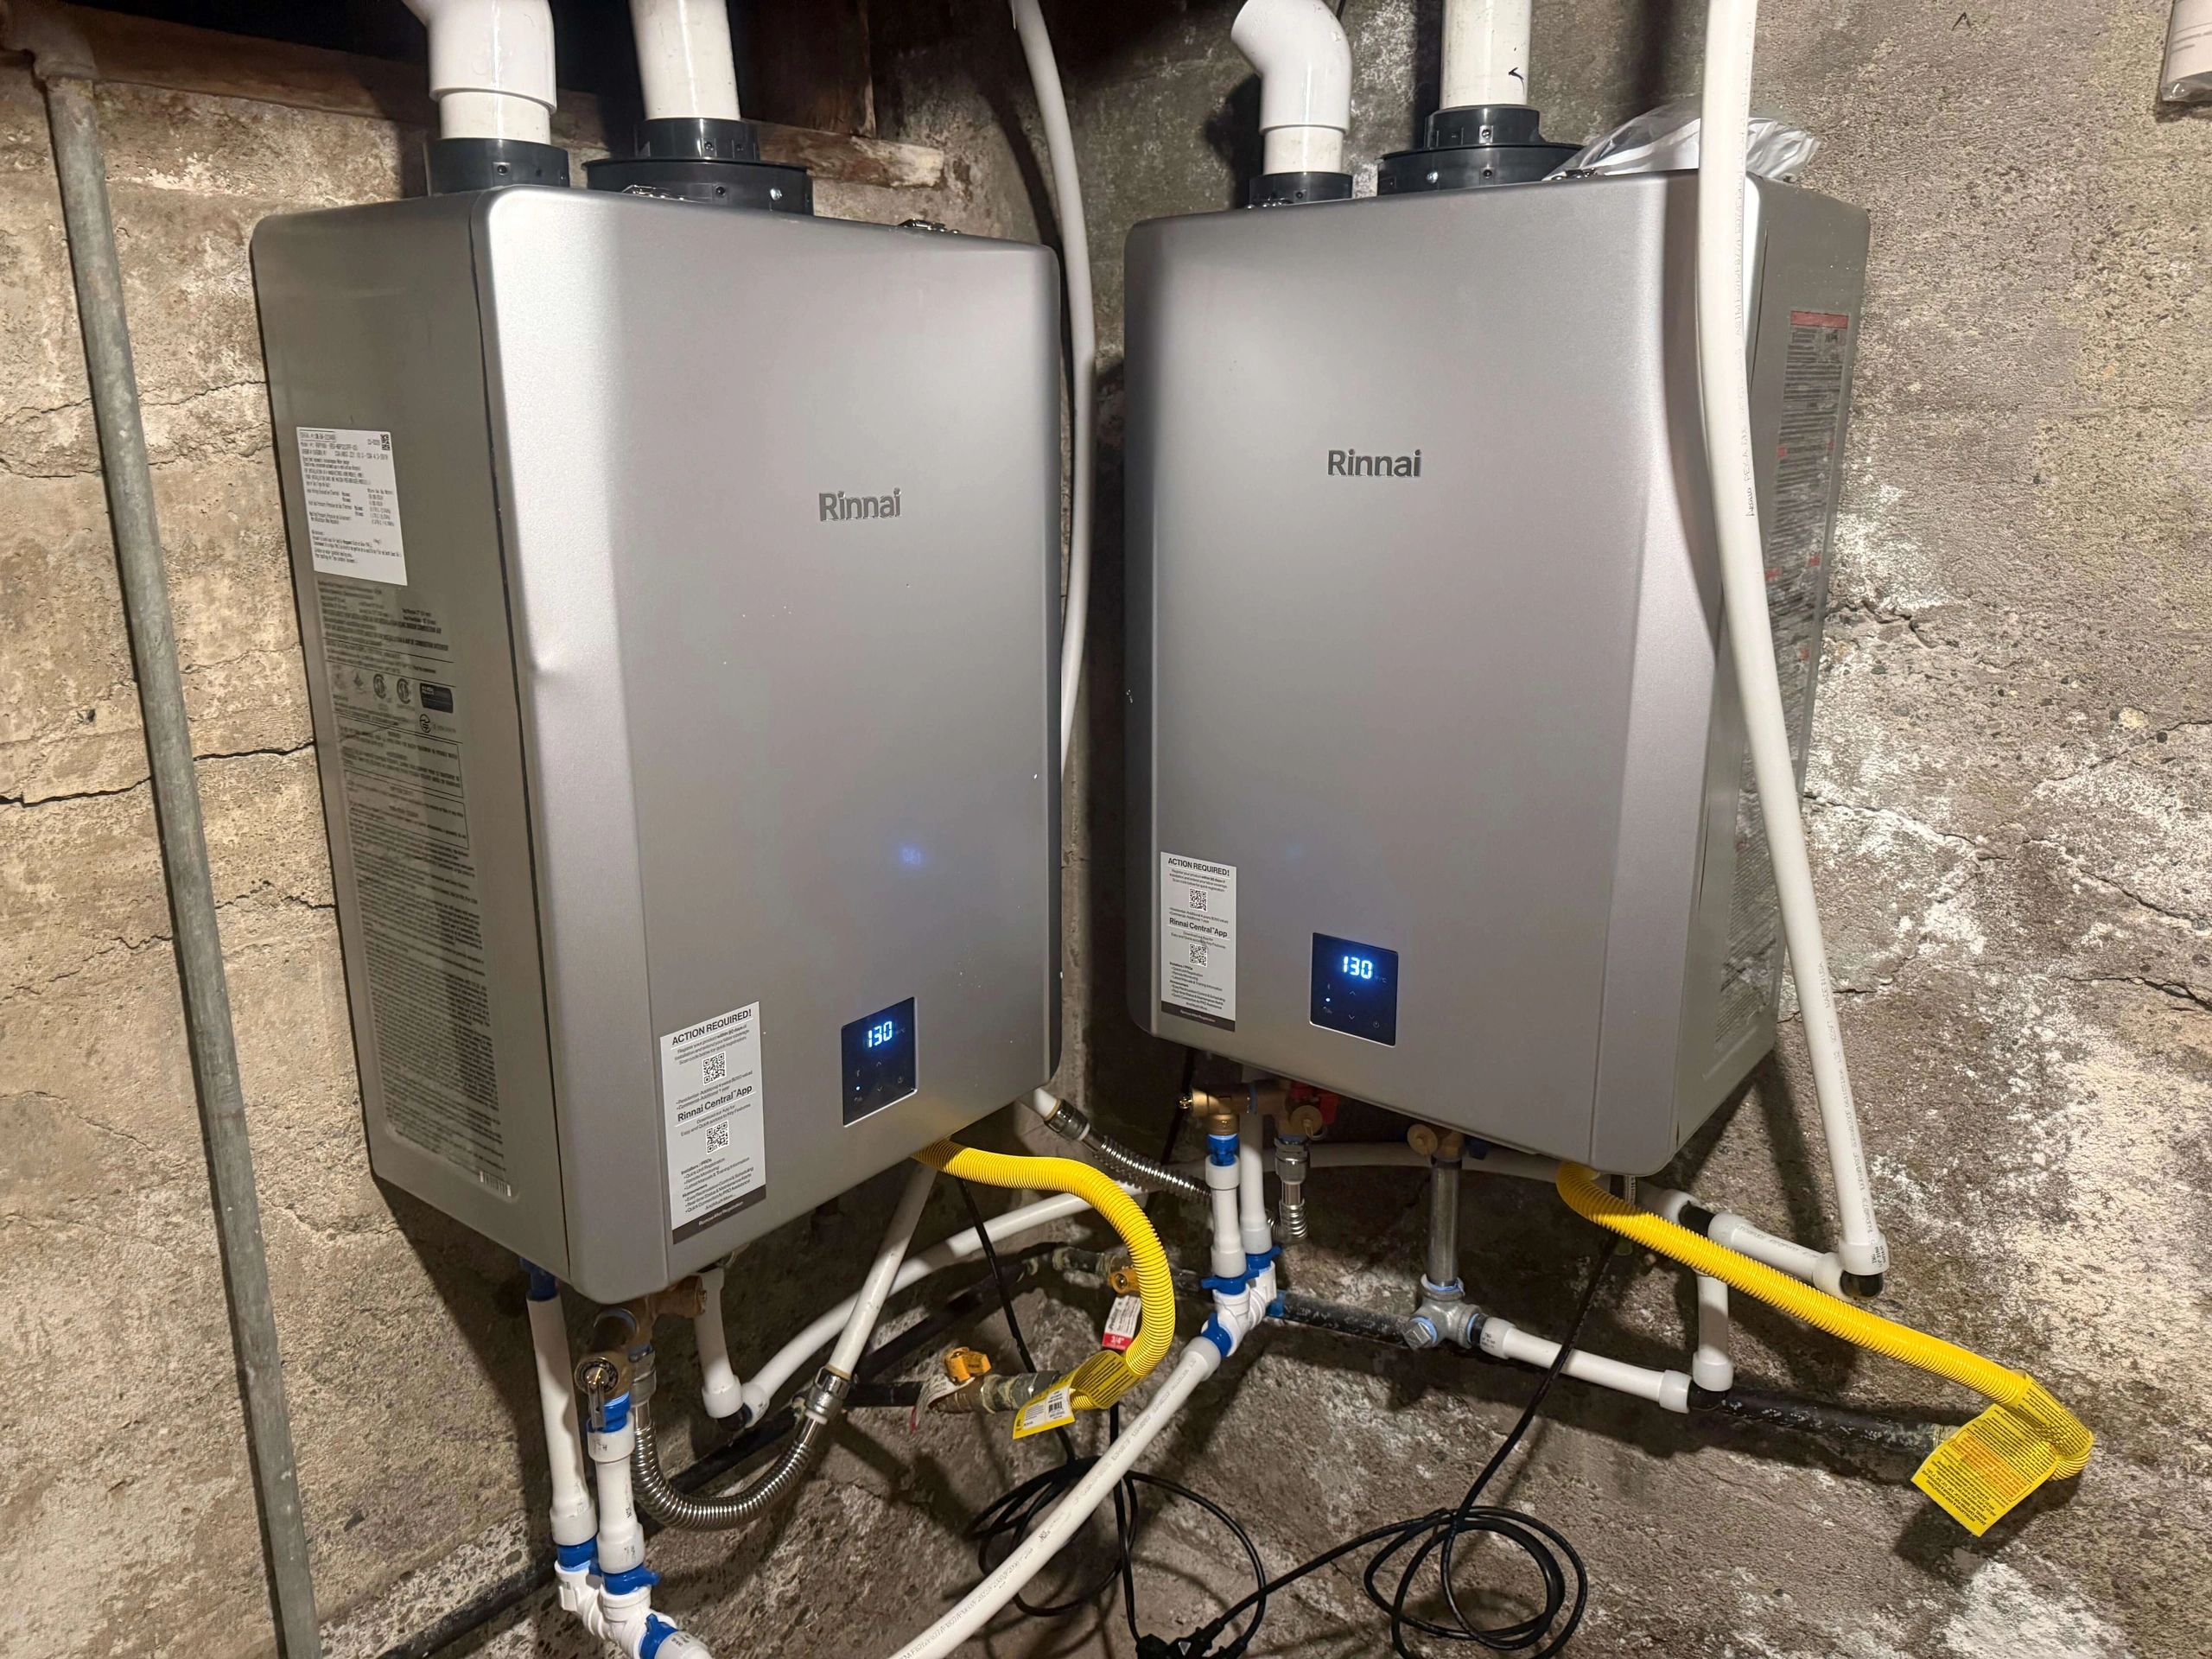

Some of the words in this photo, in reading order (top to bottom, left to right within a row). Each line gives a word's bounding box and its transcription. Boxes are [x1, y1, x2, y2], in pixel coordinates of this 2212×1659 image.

[1327, 448, 1421, 477] Rinnai
[818, 487, 902, 522] Rinnai
[1167, 858, 1192, 868] ACTION
[1192, 862, 1229, 875] REQUIRED!
[1169, 918, 1188, 927] Rinnai
[1214, 928, 1227, 938] App
[1343, 955, 1373, 980] 130
[671, 1027, 705, 1046] ACTION
[706, 1009, 751, 1033] REQUIRED!
[868, 1020, 893, 1048] 130
[677, 1104, 703, 1121] Rinnai
[735, 1084, 753, 1098] App
